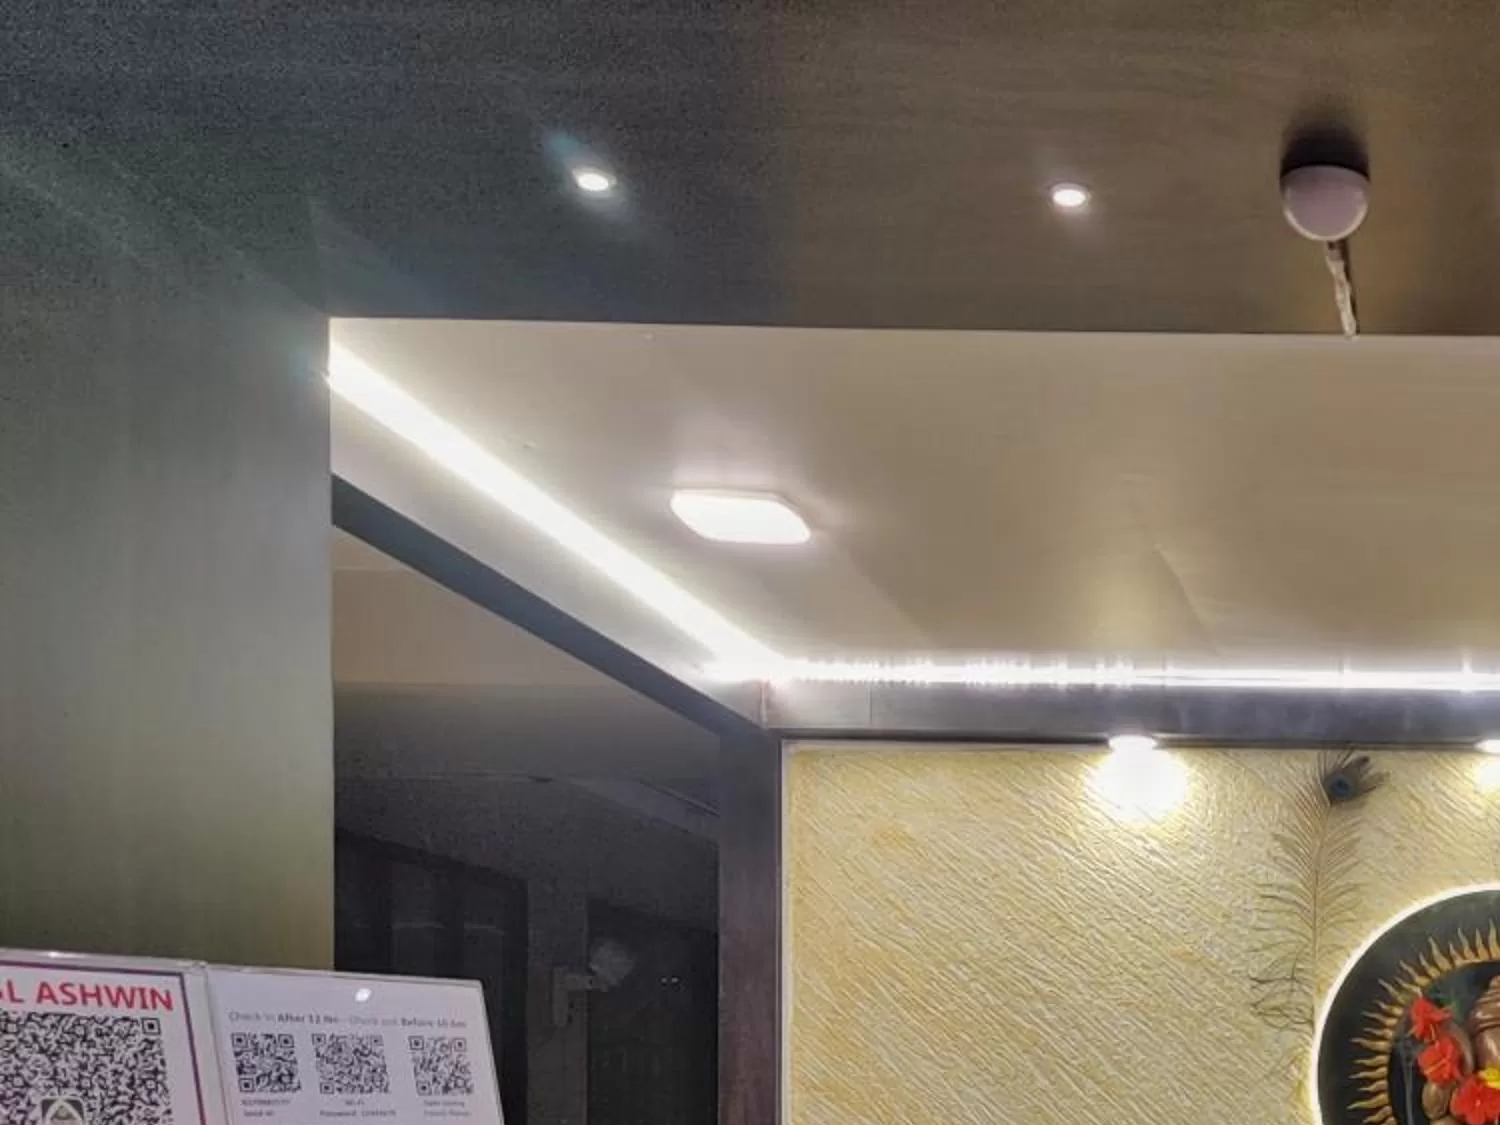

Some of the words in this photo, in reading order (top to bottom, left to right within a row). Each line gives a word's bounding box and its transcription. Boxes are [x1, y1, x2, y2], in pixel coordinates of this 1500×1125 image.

[0, 979, 24, 1004] L
[36, 981, 174, 1012] ASHWIN
[278, 1013, 305, 1023] After
